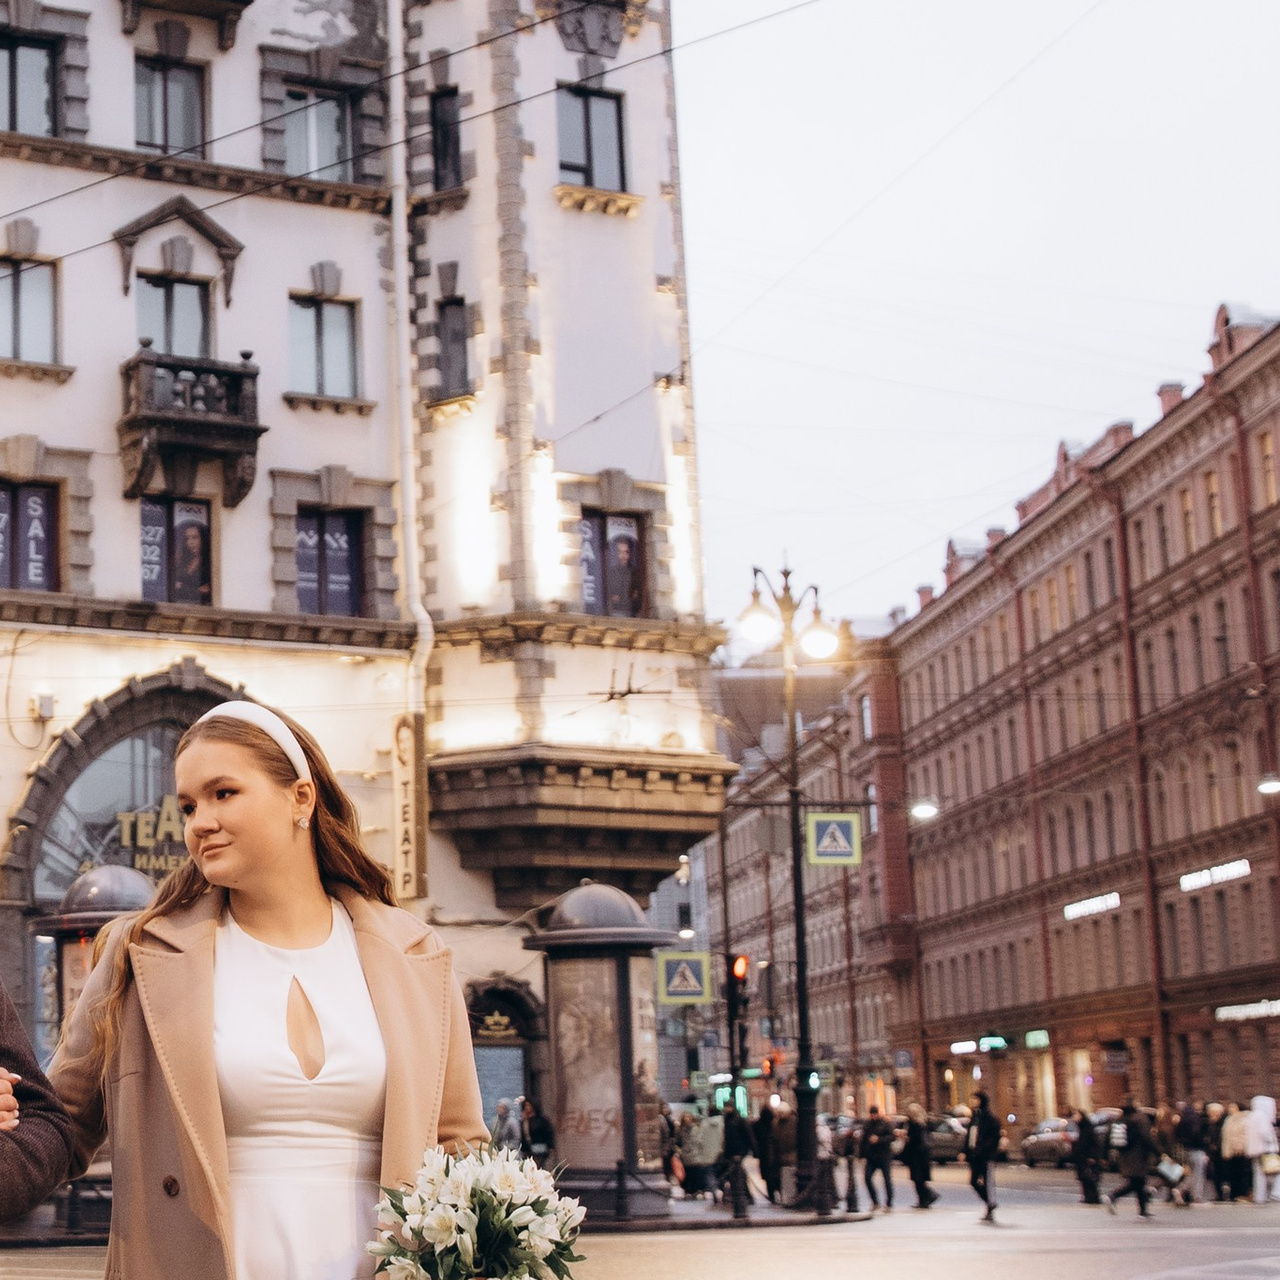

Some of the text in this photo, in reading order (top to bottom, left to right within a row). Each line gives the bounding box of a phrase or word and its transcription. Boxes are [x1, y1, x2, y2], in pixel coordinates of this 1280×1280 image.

[27, 496, 45, 582] SALE
[579, 520, 596, 603] SALE
[401, 781, 413, 891] ТЕАТР
